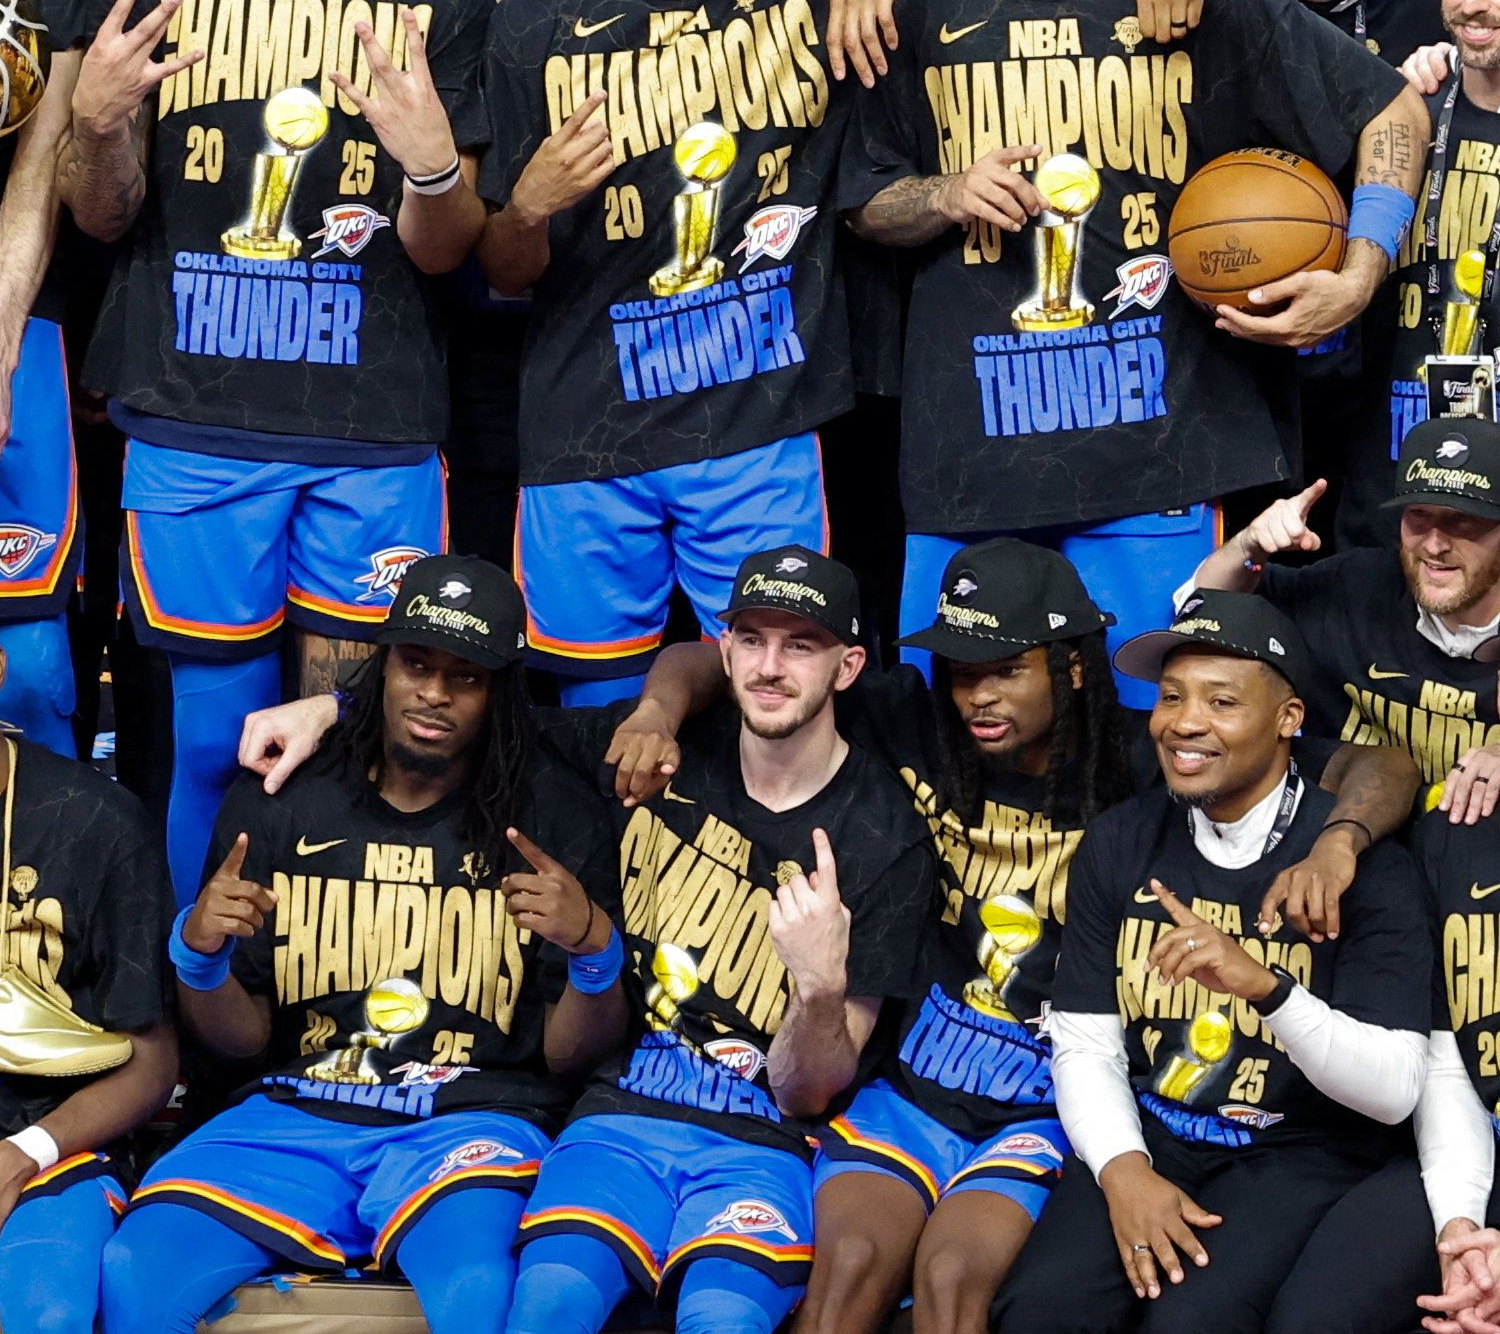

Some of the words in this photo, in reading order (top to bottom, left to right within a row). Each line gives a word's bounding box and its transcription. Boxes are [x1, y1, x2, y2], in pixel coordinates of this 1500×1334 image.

[649, 6, 711, 46] NBA
[1009, 20, 1082, 58] NBA
[925, 51, 1193, 184] CHAMPIONS
[184, 125, 224, 183] 20
[339, 140, 376, 195] 25
[329, 218, 367, 241] OKC
[605, 185, 643, 240] 20
[750, 217, 788, 248] OKC
[1122, 192, 1159, 250] 25
[174, 252, 303, 278] OKLAHOMA
[313, 264, 361, 281] CITY
[1123, 264, 1161, 297] OKC
[609, 282, 737, 319] OKLAHOMA
[744, 267, 792, 292] CITY
[173, 272, 363, 365] THUNDER
[973, 326, 1109, 353] OKLAHOMA
[1117, 315, 1163, 337] CITY
[612, 286, 805, 401] THUNDER
[976, 337, 1168, 437] THUNDER
[1405, 458, 1491, 490] Champions
[742, 574, 827, 606] Champions
[406, 594, 488, 634] Champions
[1419, 680, 1477, 719] NBA
[981, 800, 1049, 834] NBA
[366, 844, 435, 884] NBA
[694, 813, 753, 877] NBA
[273, 871, 531, 1035] CHAMPIONS
[901, 1000, 1054, 1104] THUNDE
[1230, 1057, 1269, 1101] 25
